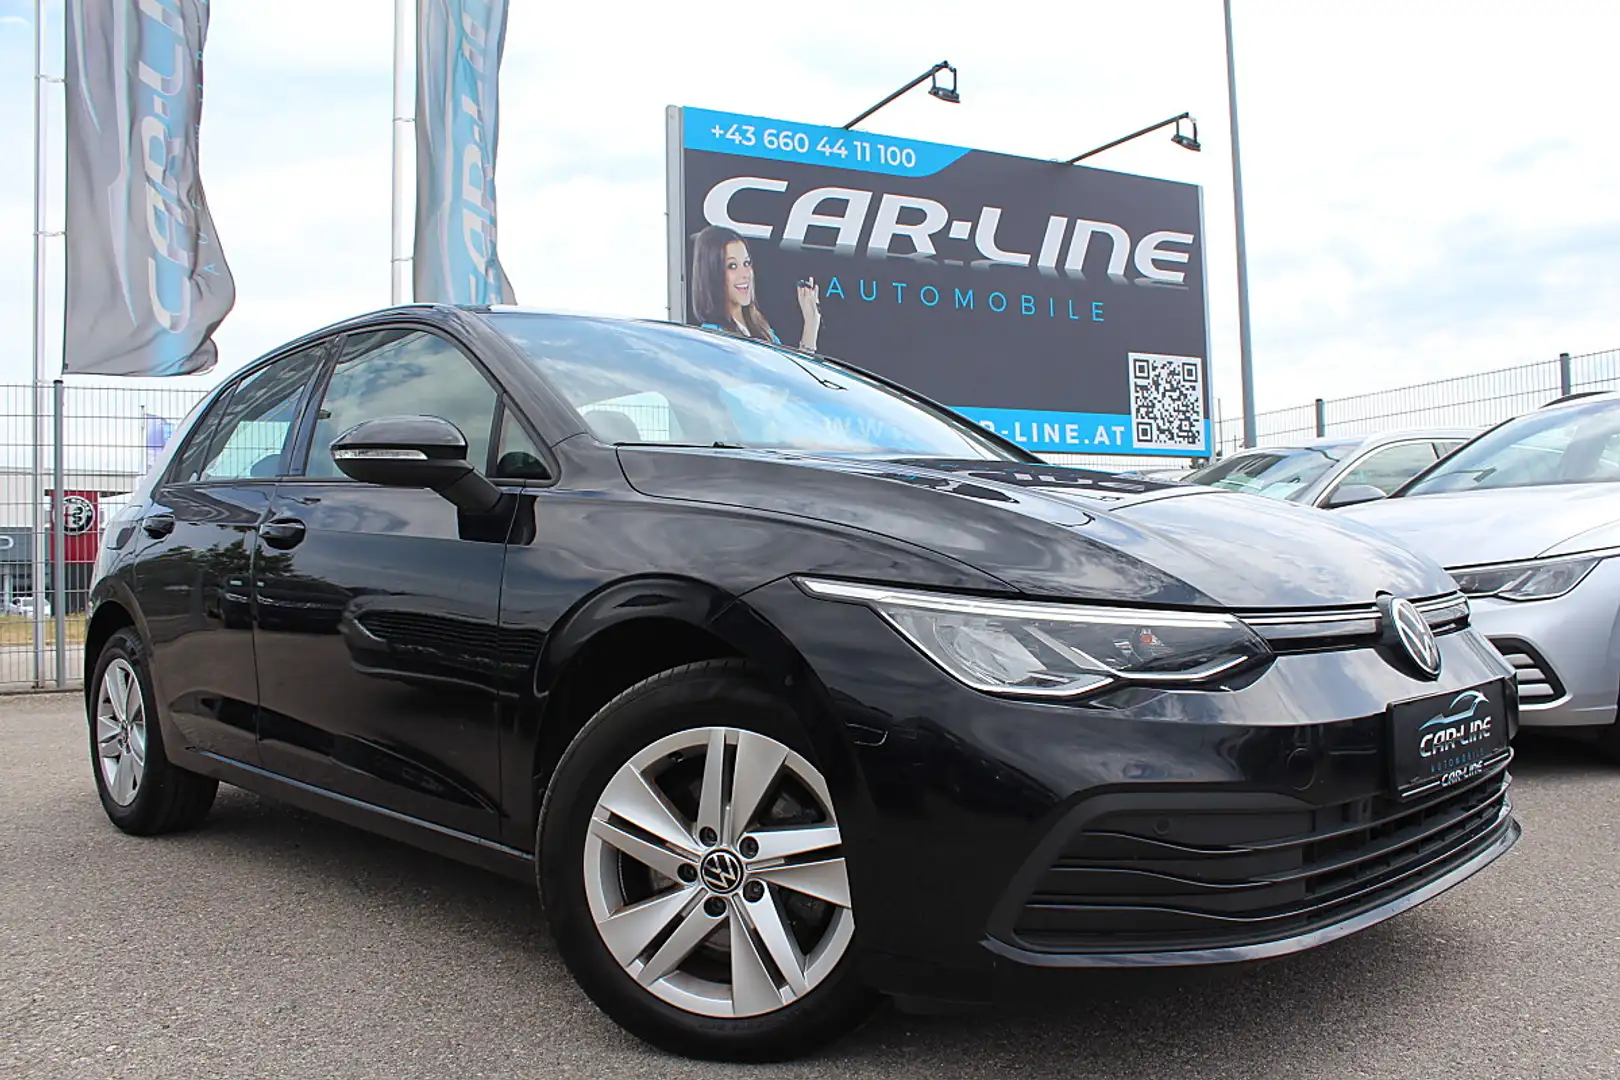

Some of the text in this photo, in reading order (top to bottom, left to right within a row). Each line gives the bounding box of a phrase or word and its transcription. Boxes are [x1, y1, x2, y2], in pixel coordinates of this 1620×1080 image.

[711, 123, 917, 168] +43 660 44 11 100
[825, 277, 1106, 323] AUTOMOBILE
